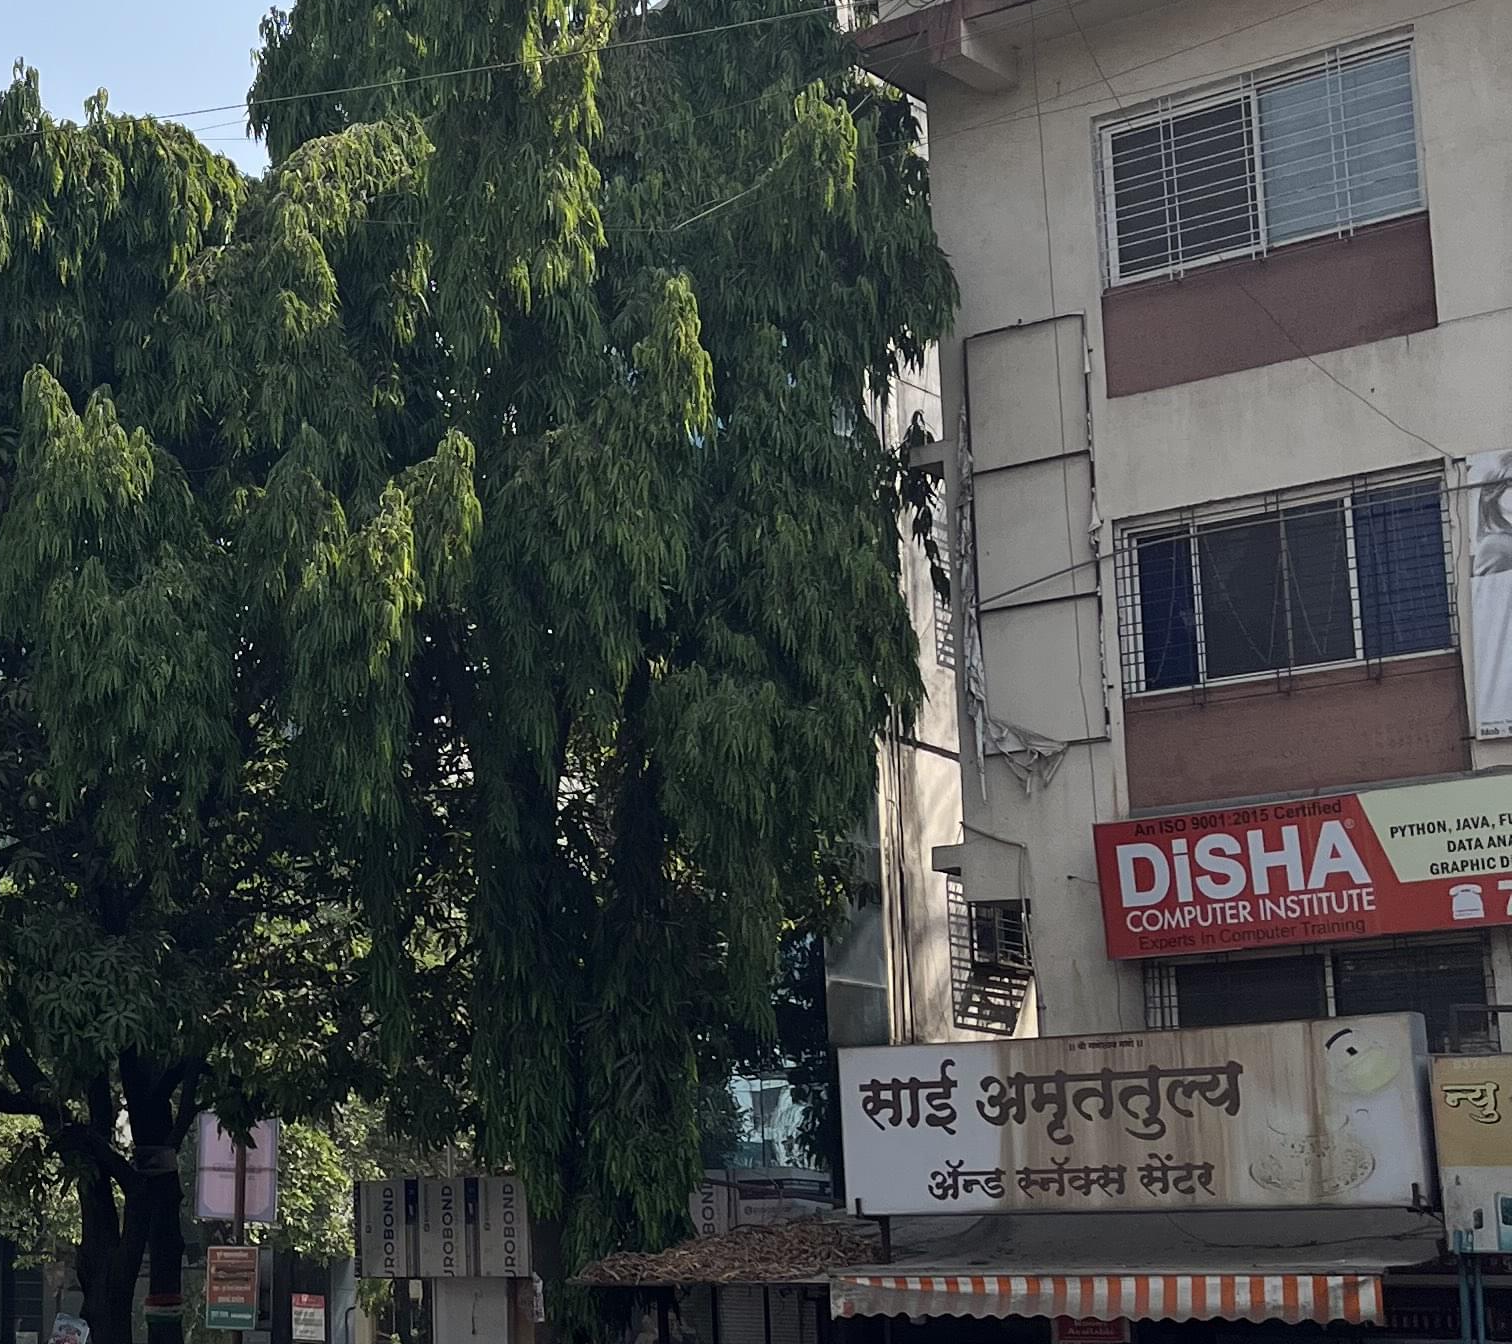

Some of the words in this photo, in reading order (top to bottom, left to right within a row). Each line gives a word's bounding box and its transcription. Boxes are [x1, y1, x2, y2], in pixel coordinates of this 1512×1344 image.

[1134, 823, 1156, 837] An
[1159, 821, 1186, 834] ISO
[1191, 809, 1269, 830] 9001:2015
[1274, 800, 1342, 820] Certified
[1390, 820, 1453, 838] PYTHON,
[1456, 816, 1495, 831] JAVA,
[1447, 838, 1484, 853] DATA
[1429, 856, 1496, 875] GRAPHIC
[1500, 855, 1512, 869] D
[1126, 903, 1253, 933] COMPUTER
[1259, 888, 1376, 922] INSTITUTE
[1139, 937, 1196, 951] Experts
[1221, 927, 1297, 944] Computer
[1302, 918, 1366, 936] Training
[859, 1058, 958, 1136] साई
[976, 1060, 1244, 1146] अमृततुल्य
[1016, 1157, 1128, 1199] स्नॅक्स
[1137, 1153, 1216, 1197] सेंटर
